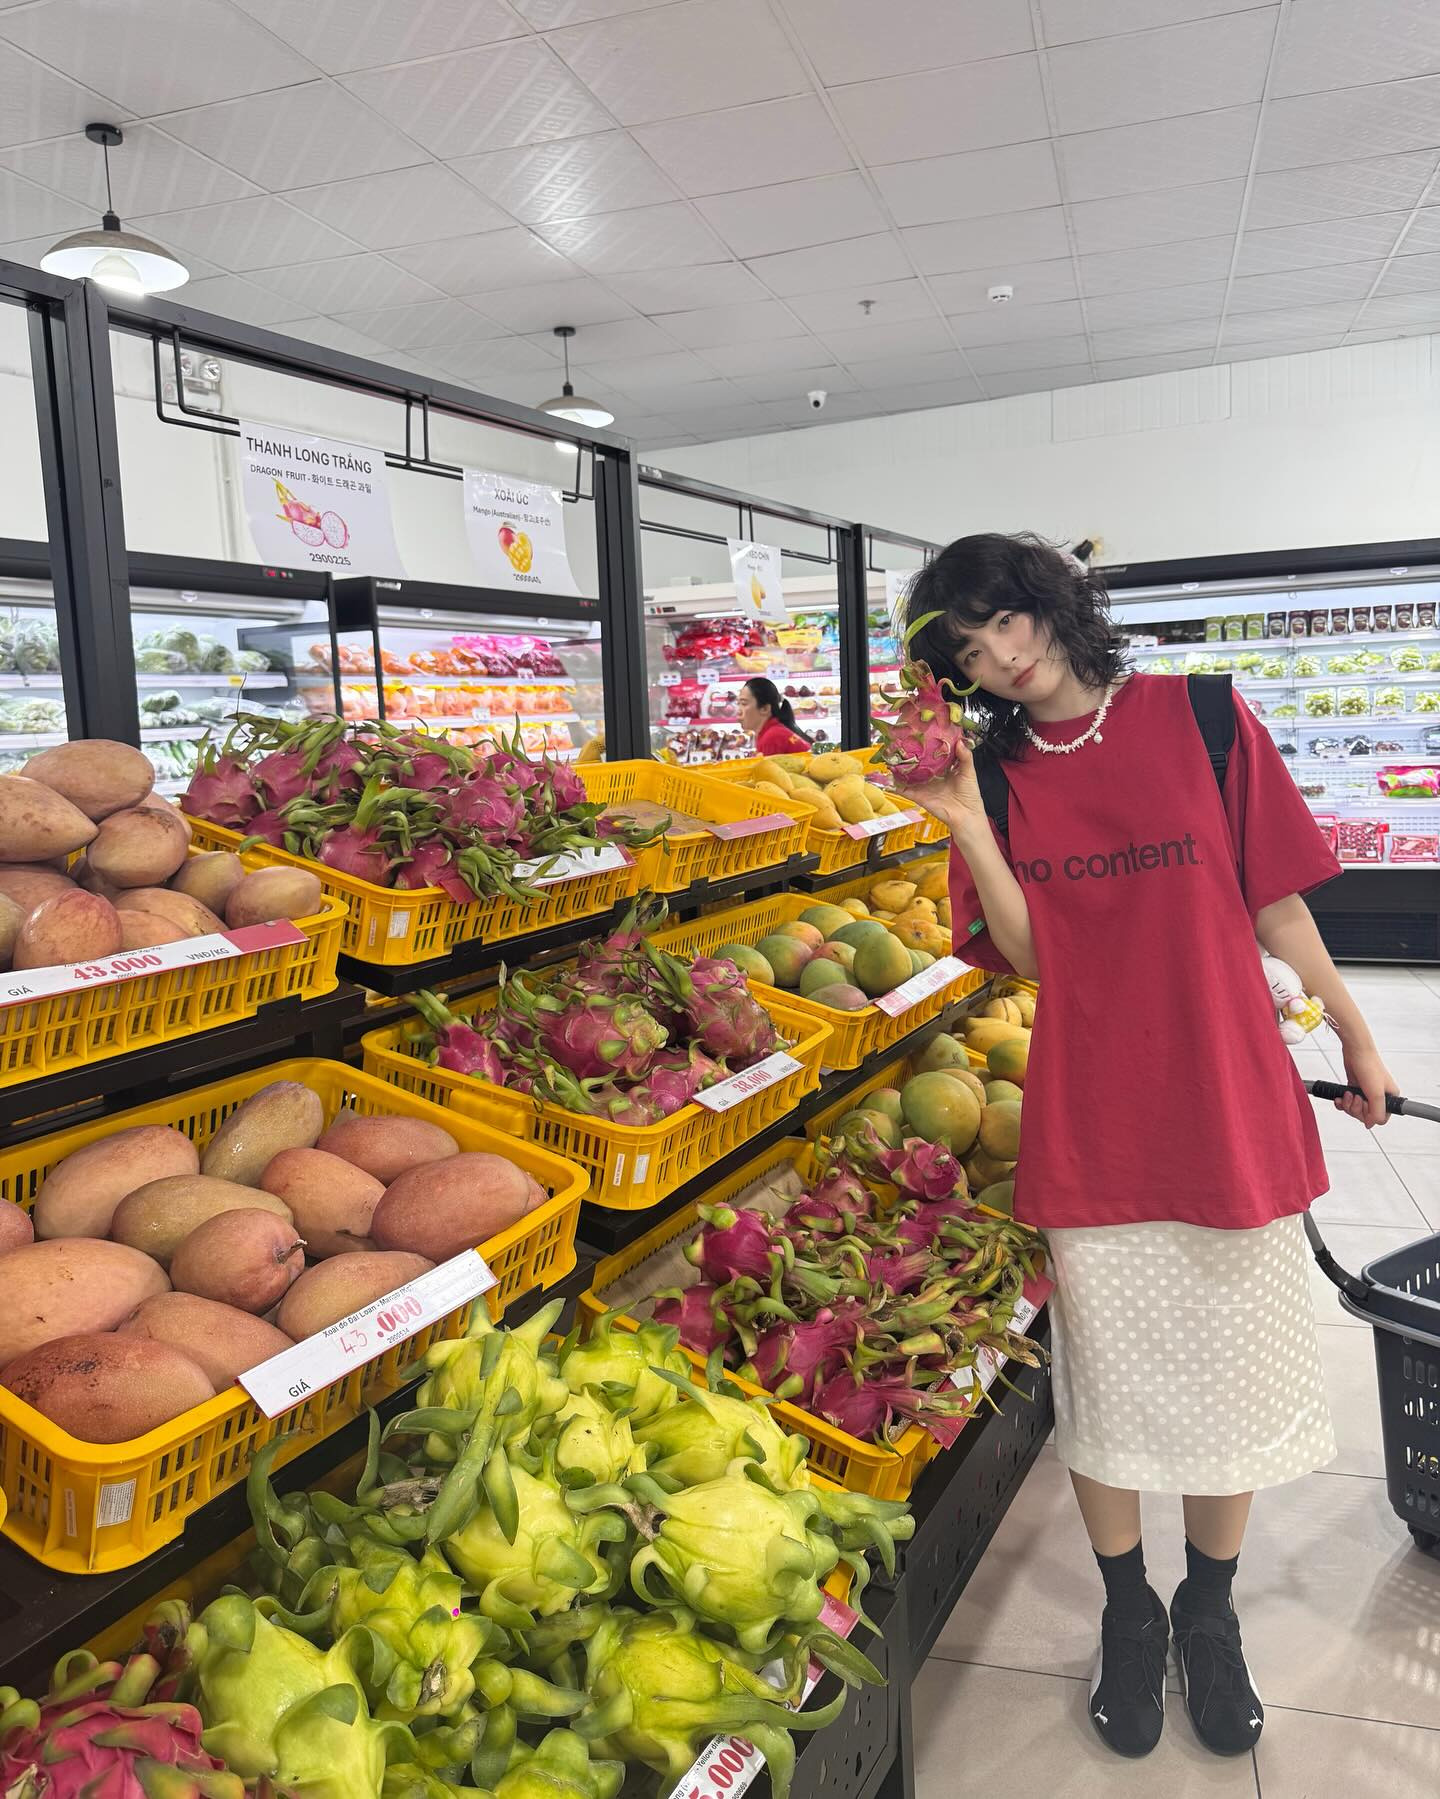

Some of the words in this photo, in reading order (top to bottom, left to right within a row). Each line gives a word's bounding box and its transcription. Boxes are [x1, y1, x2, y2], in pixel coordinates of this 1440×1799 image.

[246, 437, 292, 459] THANH
[295, 447, 330, 466] LONG
[250, 464, 283, 477] DRAGON
[286, 470, 306, 481] FRUIT
[312, 473, 334, 486] 화이트
[309, 552, 352, 566] 2900225
[1014, 858, 1053, 884] no
[8, 985, 33, 997] GIÁ
[73, 954, 163, 980] 43.000
[732, 1069, 773, 1093] 38.000
[360, 1305, 377, 1318] Loan
[288, 1378, 312, 1398] GIÁ
[696, 1750, 714, 1768] Yellow
